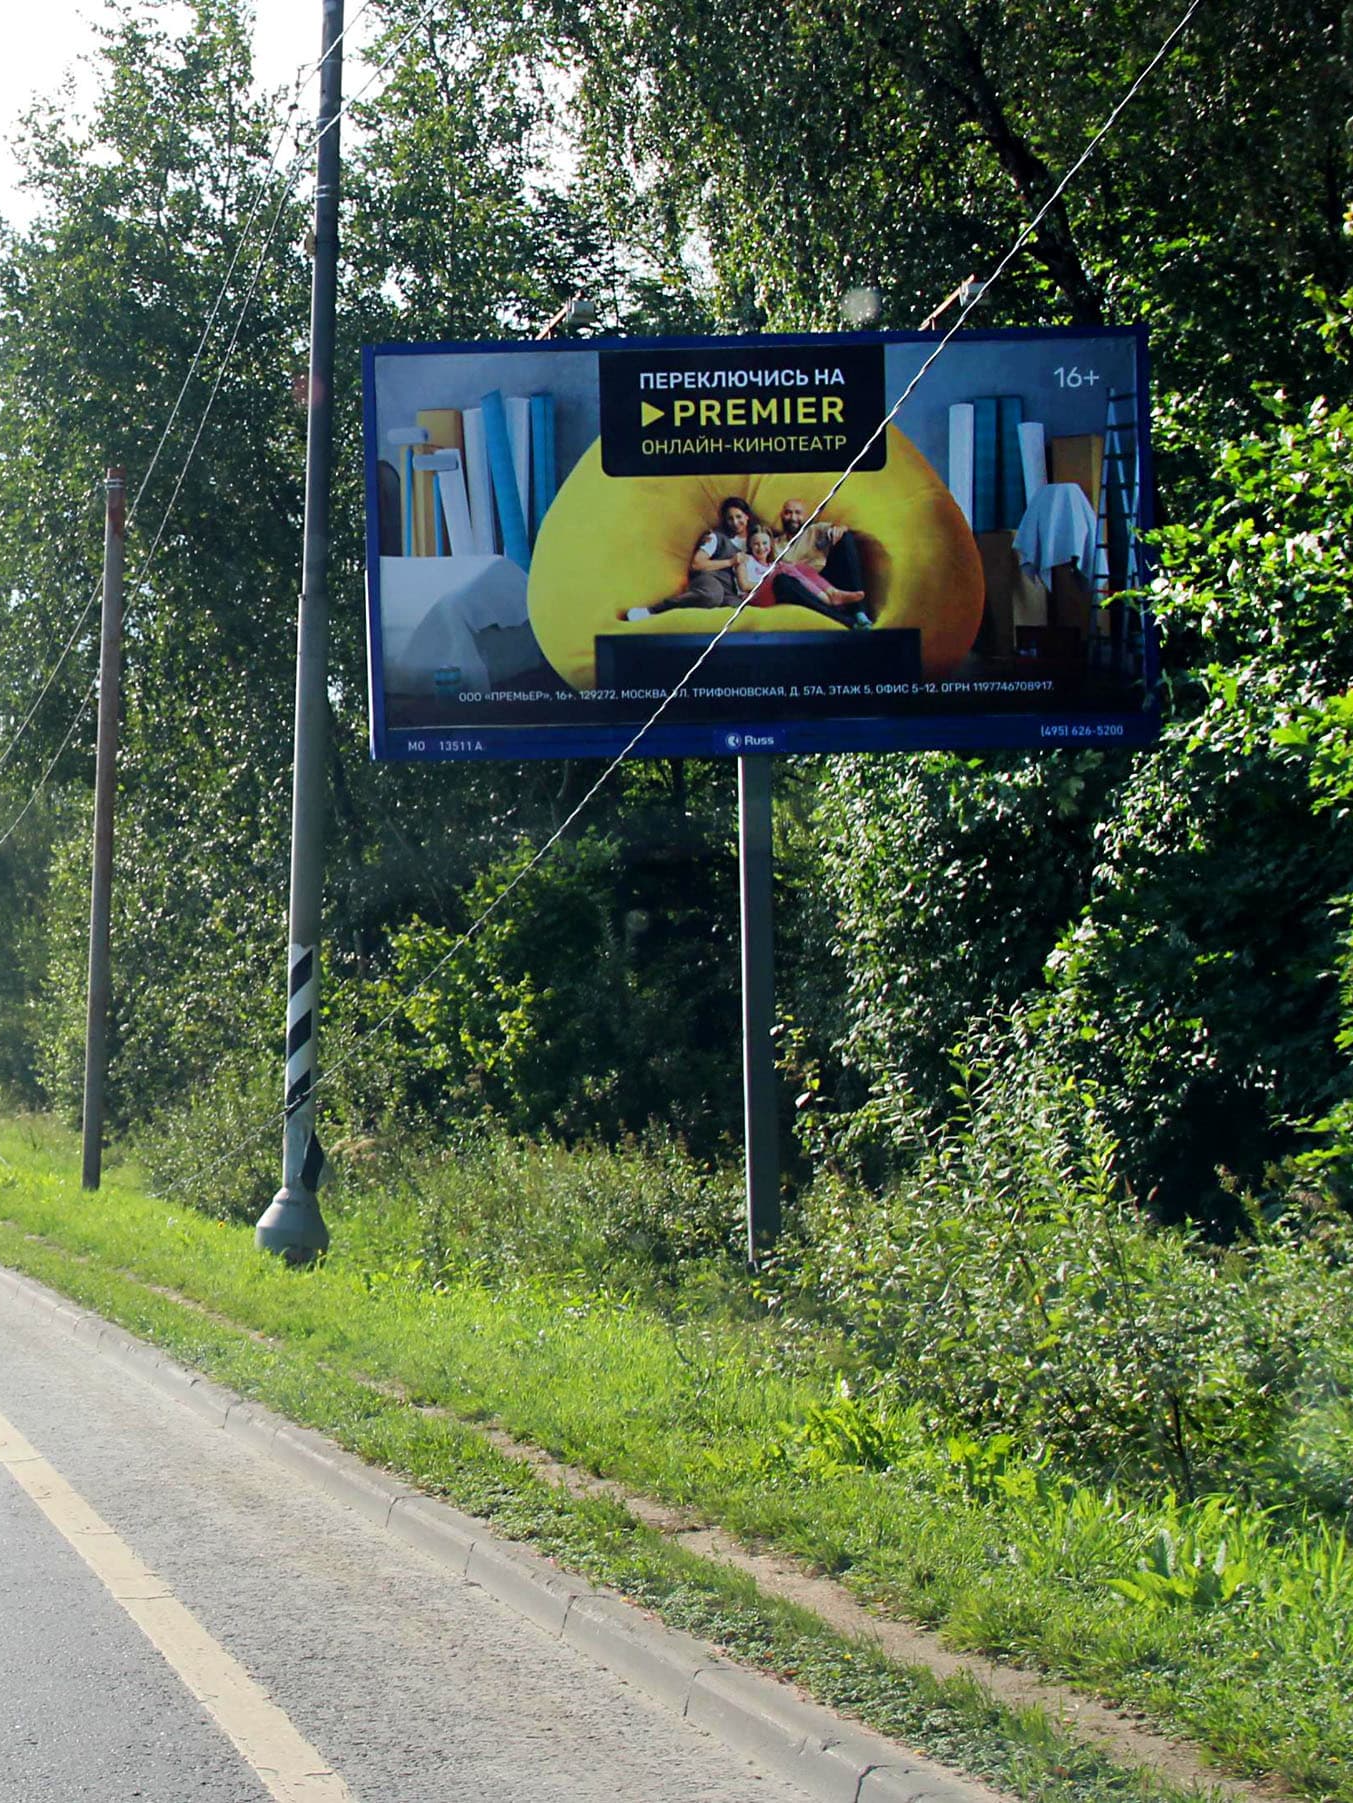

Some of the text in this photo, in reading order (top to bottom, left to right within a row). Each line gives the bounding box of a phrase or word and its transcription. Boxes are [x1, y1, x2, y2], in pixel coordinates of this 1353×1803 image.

[639, 368, 846, 390] ПЕРЕКЛЮЧИСЬ НА
[1053, 366, 1100, 388] 16+
[673, 396, 845, 427] PREMIER
[641, 435, 847, 455] ОНЛАЙН-КИНОТЕАТР
[458, 691, 482, 702] ООО
[828, 684, 861, 696] ЭТАЖ
[875, 683, 909, 695] ОФИС
[941, 682, 970, 693] ОГРН
[744, 735, 775, 746] Russ
[1071, 725, 1124, 736] 626-5200
